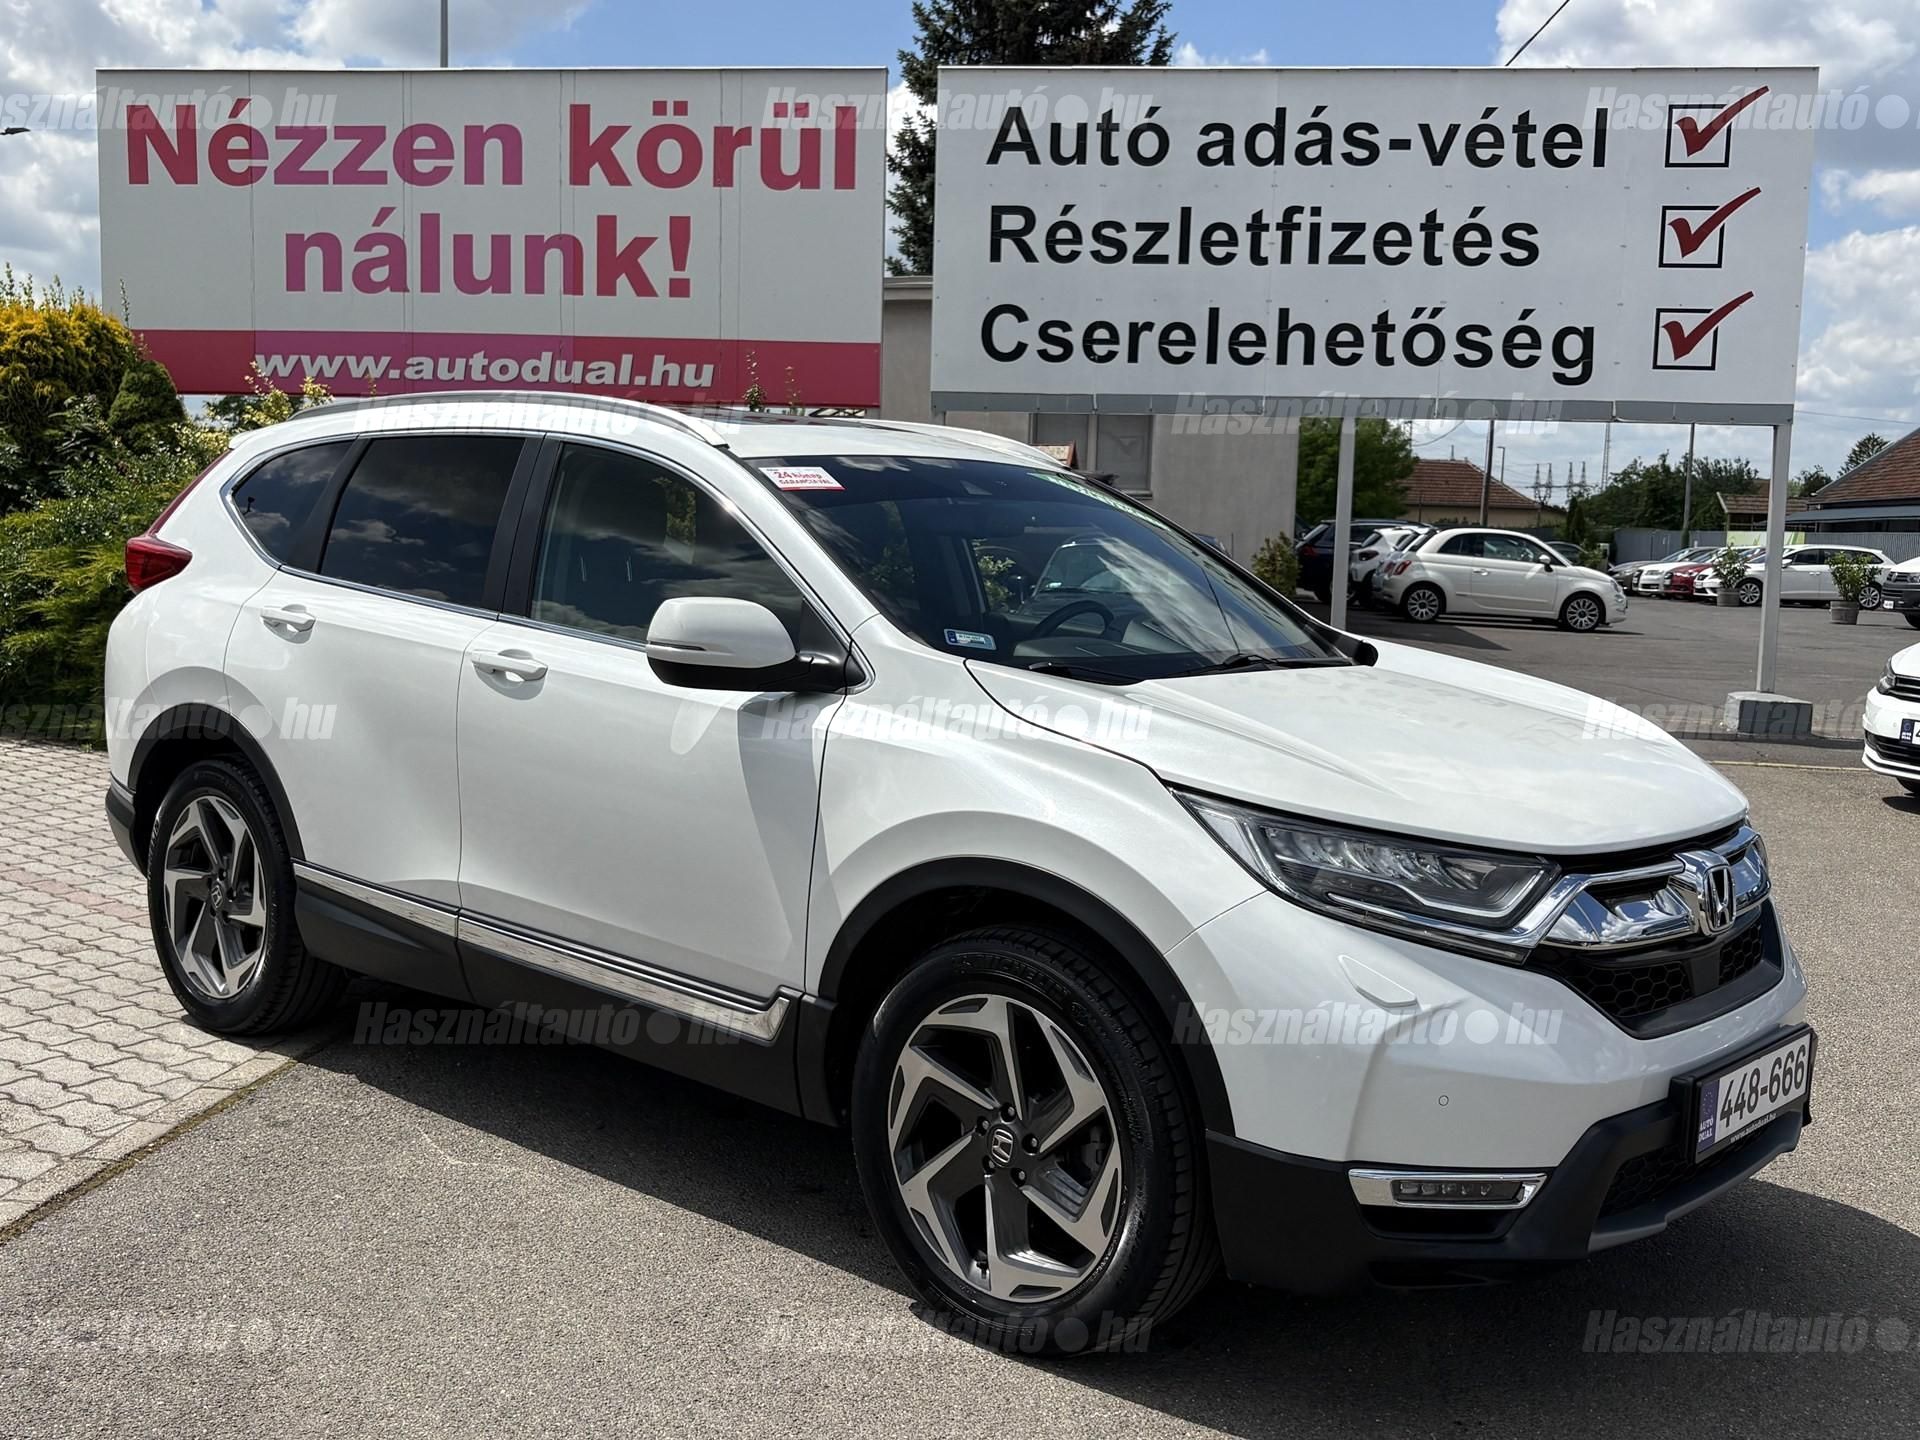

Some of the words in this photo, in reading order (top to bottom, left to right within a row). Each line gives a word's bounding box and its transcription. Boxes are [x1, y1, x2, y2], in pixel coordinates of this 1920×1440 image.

[126, 98, 523, 187] Nézzen
[568, 100, 857, 191] körül
[986, 106, 1171, 167] Autó
[1197, 106, 1608, 169] adás-vétel
[284, 206, 693, 299] nálunk!
[989, 203, 1541, 266] Részletfizetés
[255, 351, 714, 388] www.autodual.hu
[980, 303, 1596, 386] Cserelehetőség
[1719, 1044, 1806, 1128] 448-666
